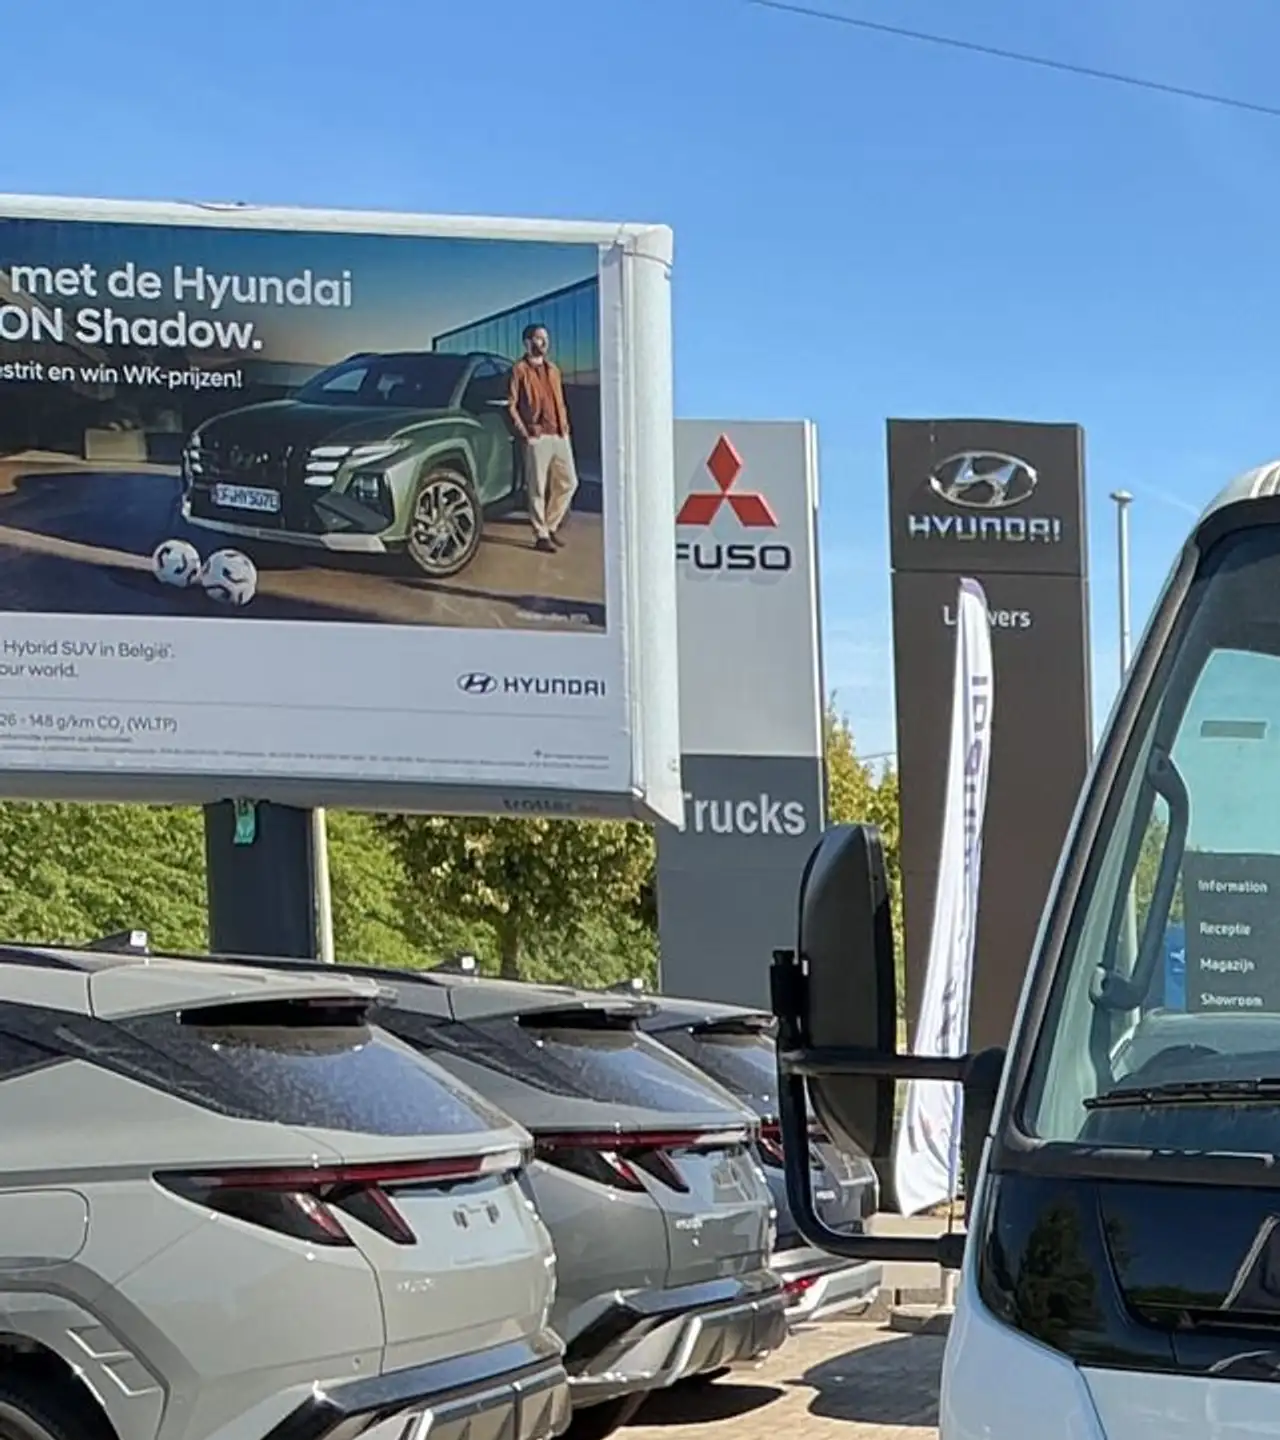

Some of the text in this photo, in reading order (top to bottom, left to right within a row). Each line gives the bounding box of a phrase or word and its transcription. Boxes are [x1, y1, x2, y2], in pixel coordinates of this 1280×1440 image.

[10, 262, 352, 309] met de Hyundai
[75, 308, 264, 351] Shadow.
[48, 365, 75, 381] en
[80, 363, 118, 383] win
[122, 363, 243, 391] WK-prijzen!
[908, 514, 1061, 543] HYUNDAI
[943, 605, 1032, 628] Lwers
[3, 640, 58, 658] Hybrid
[61, 640, 97, 656] SUV
[100, 640, 115, 656] in
[503, 676, 606, 697] HYUNDAI
[679, 793, 807, 836] rucks
[1198, 879, 1268, 894] Information
[1199, 921, 1252, 937] Receptie
[1199, 958, 1256, 974] Magazijn
[1200, 992, 1264, 1007] Showroom
